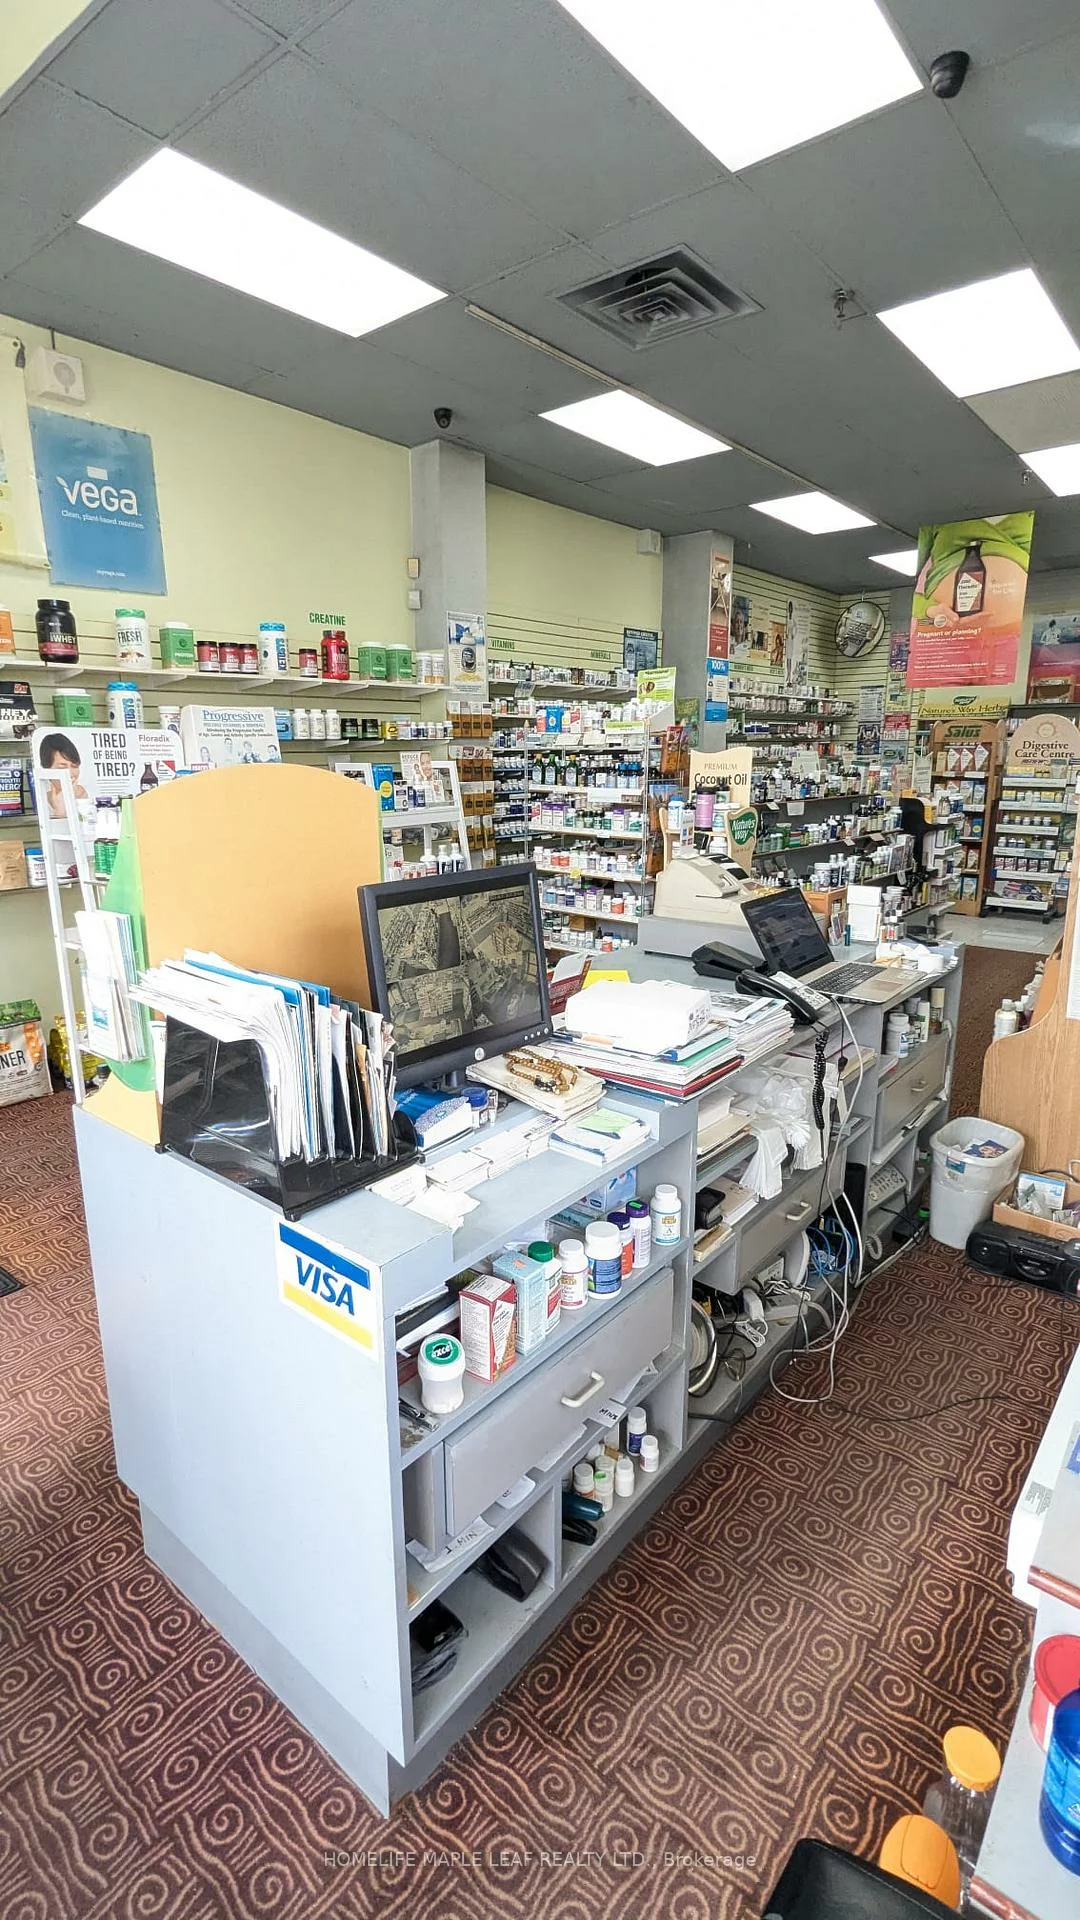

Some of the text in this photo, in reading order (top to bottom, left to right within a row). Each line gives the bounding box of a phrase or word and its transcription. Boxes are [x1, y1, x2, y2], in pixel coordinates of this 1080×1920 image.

[61, 479, 138, 516] vega
[309, 612, 346, 626] CREATINE
[952, 627, 982, 636] planning?
[52, 633, 77, 645] WHEY
[0, 708, 30, 717] HEY
[122, 698, 137, 729] ETOSYS
[958, 705, 976, 713] Way
[202, 710, 264, 722] Progressive
[944, 725, 982, 738] Salus
[91, 733, 126, 748] TIRED
[138, 734, 170, 743] Floradix
[1015, 750, 1075, 758] Care Centre
[1022, 741, 1069, 754] Digestive
[93, 750, 103, 760] OF
[105, 750, 128, 760] BEING
[94, 763, 136, 777] TIRED?
[734, 773, 747, 785] Oil
[732, 819, 755, 832] Nature's
[734, 829, 750, 842] Way
[0, 1050, 26, 1070] NER
[296, 1254, 354, 1316] VISA
[431, 1340, 453, 1358] excel
